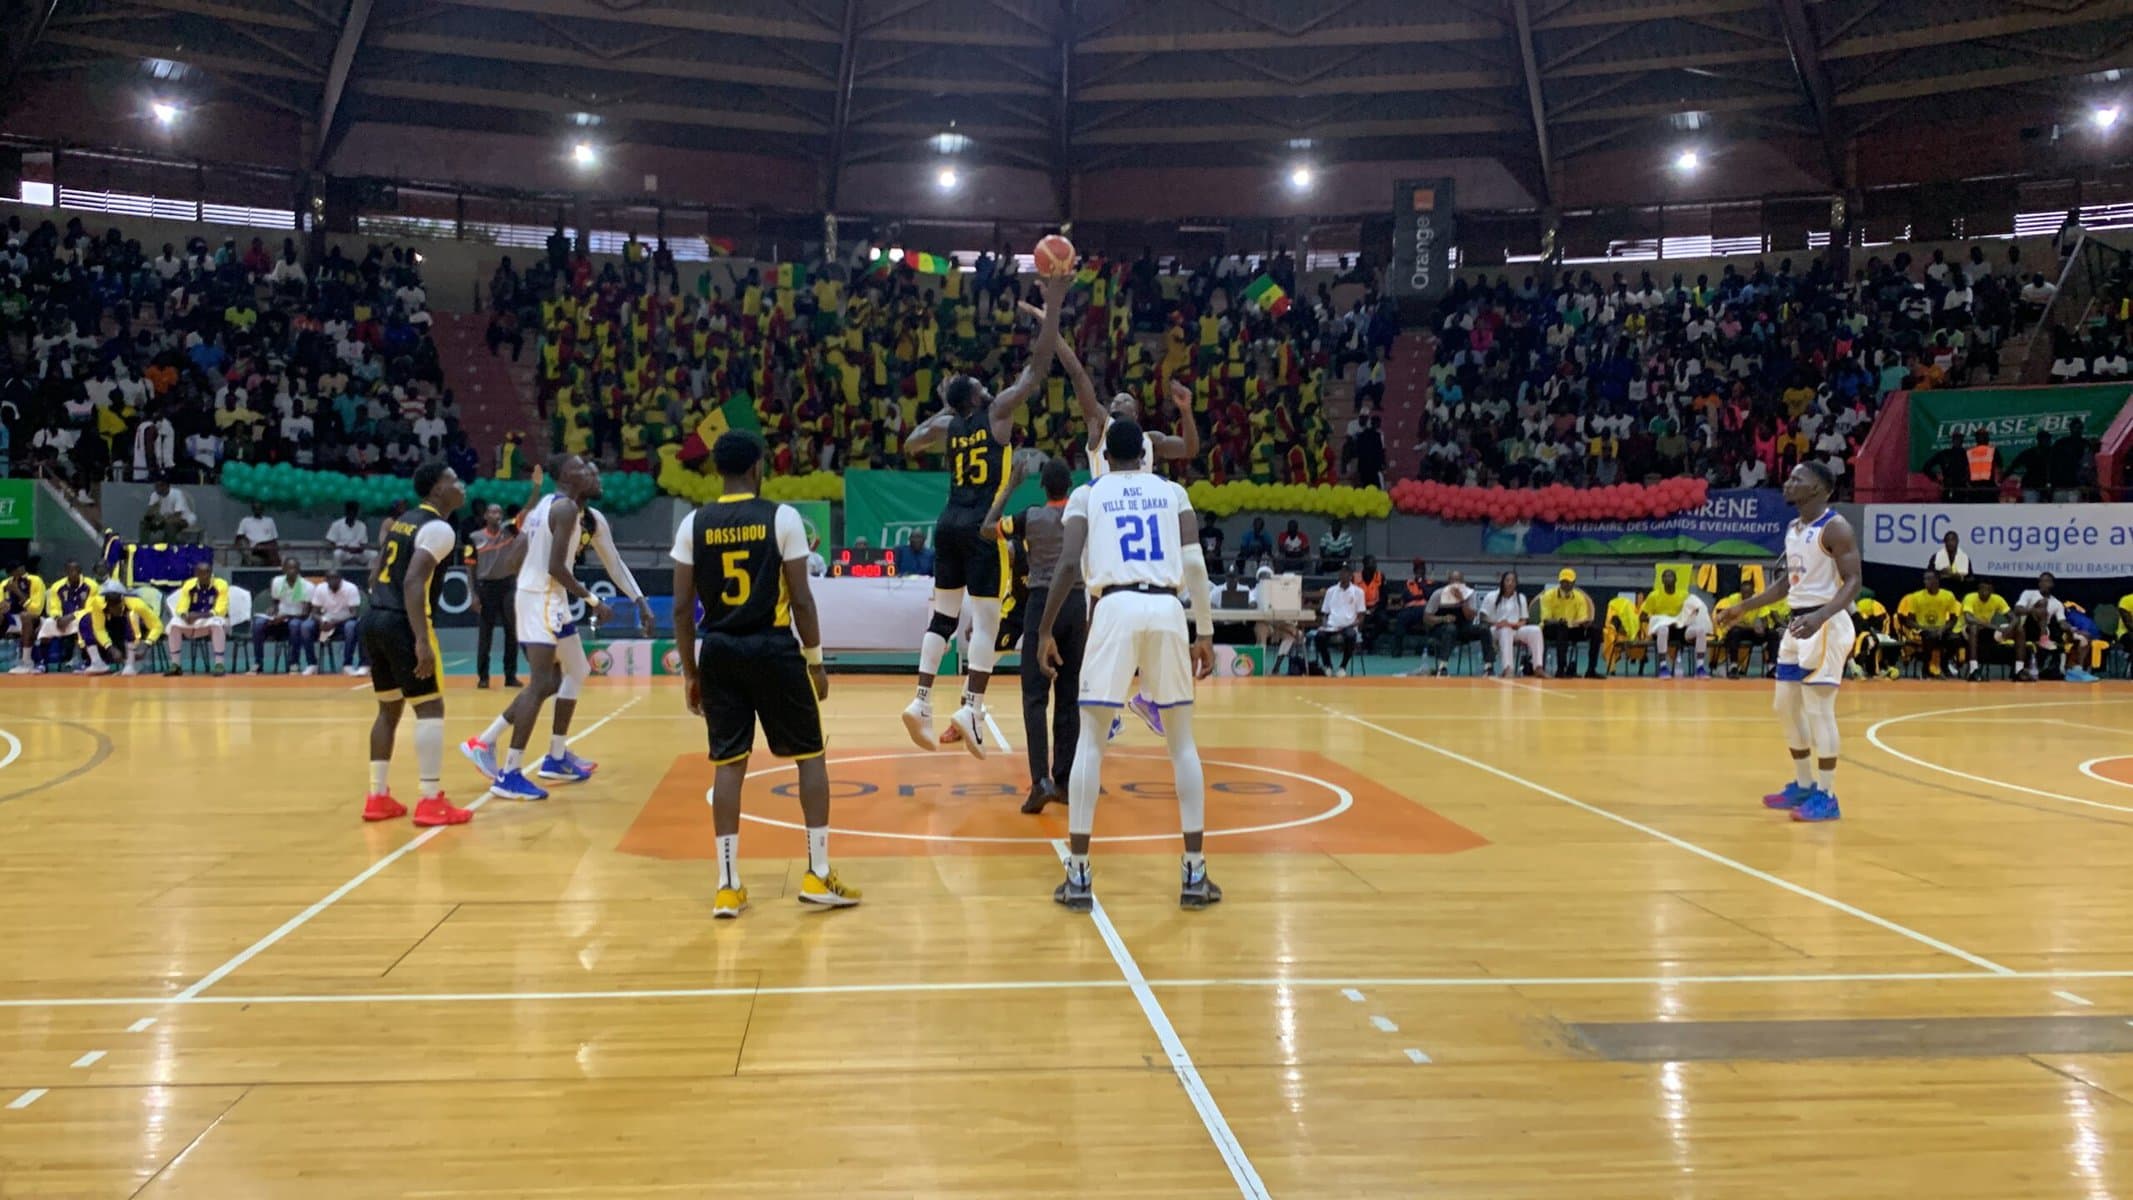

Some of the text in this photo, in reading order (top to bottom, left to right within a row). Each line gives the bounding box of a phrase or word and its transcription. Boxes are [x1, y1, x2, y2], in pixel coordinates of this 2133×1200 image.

[1411, 215, 1434, 290] Orange
[951, 428, 987, 449] ISSA
[955, 446, 988, 486] 15
[1102, 497, 1168, 513] VILLE DE DAKAR
[1122, 487, 1143, 497] ASC
[1116, 514, 1165, 562] 21
[1627, 520, 1649, 532] DES
[1651, 517, 1697, 531] GRANDS
[1700, 520, 1781, 534] EVENEMENTS
[1874, 514, 1951, 545] BSIC
[1970, 517, 2099, 552] engagée
[378, 540, 399, 584] 2
[1987, 561, 2061, 574] PARTENAIRE
[2065, 563, 2083, 573] DU
[721, 550, 751, 606] 5
[770, 780, 1287, 799] Orage
